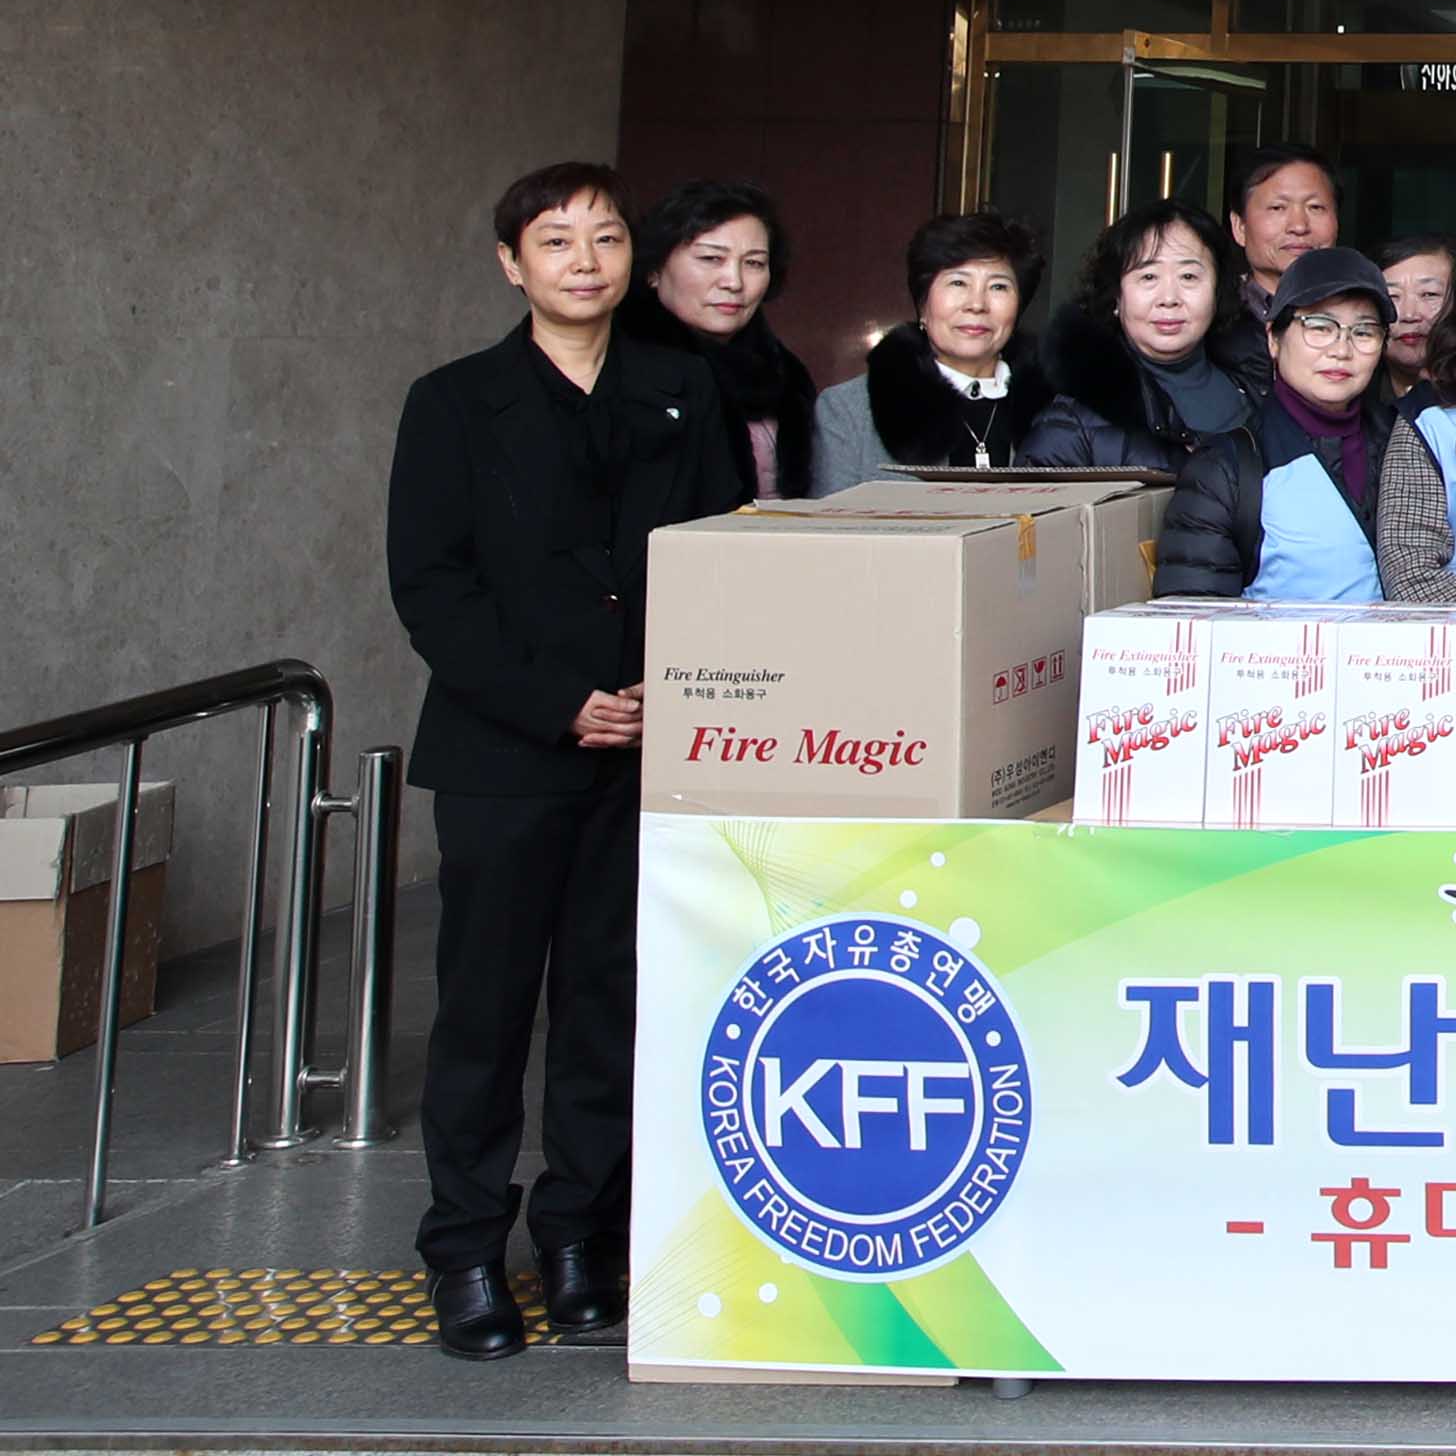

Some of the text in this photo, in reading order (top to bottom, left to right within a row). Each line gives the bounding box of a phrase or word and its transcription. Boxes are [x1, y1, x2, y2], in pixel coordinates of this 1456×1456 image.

[1092, 648, 1117, 661] Fire
[1219, 651, 1244, 664] Fire
[1347, 653, 1372, 666] Fire
[664, 667, 785, 686] Fire Extinguisher
[683, 686, 768, 701] 투척용 소화용구
[1086, 703, 1153, 746] Fire
[1102, 707, 1197, 770] Magic
[1215, 706, 1282, 749] Fire
[1231, 710, 1326, 773] Magic
[1343, 708, 1410, 751] Fire
[1359, 712, 1454, 775] Magic
[685, 725, 927, 776] Fire Magic
[732, 924, 997, 1025] 한국자유총연맹
[758, 1056, 971, 1152] KFF
[708, 1054, 1025, 1267] KOREA FREEDOM FEDERATION
